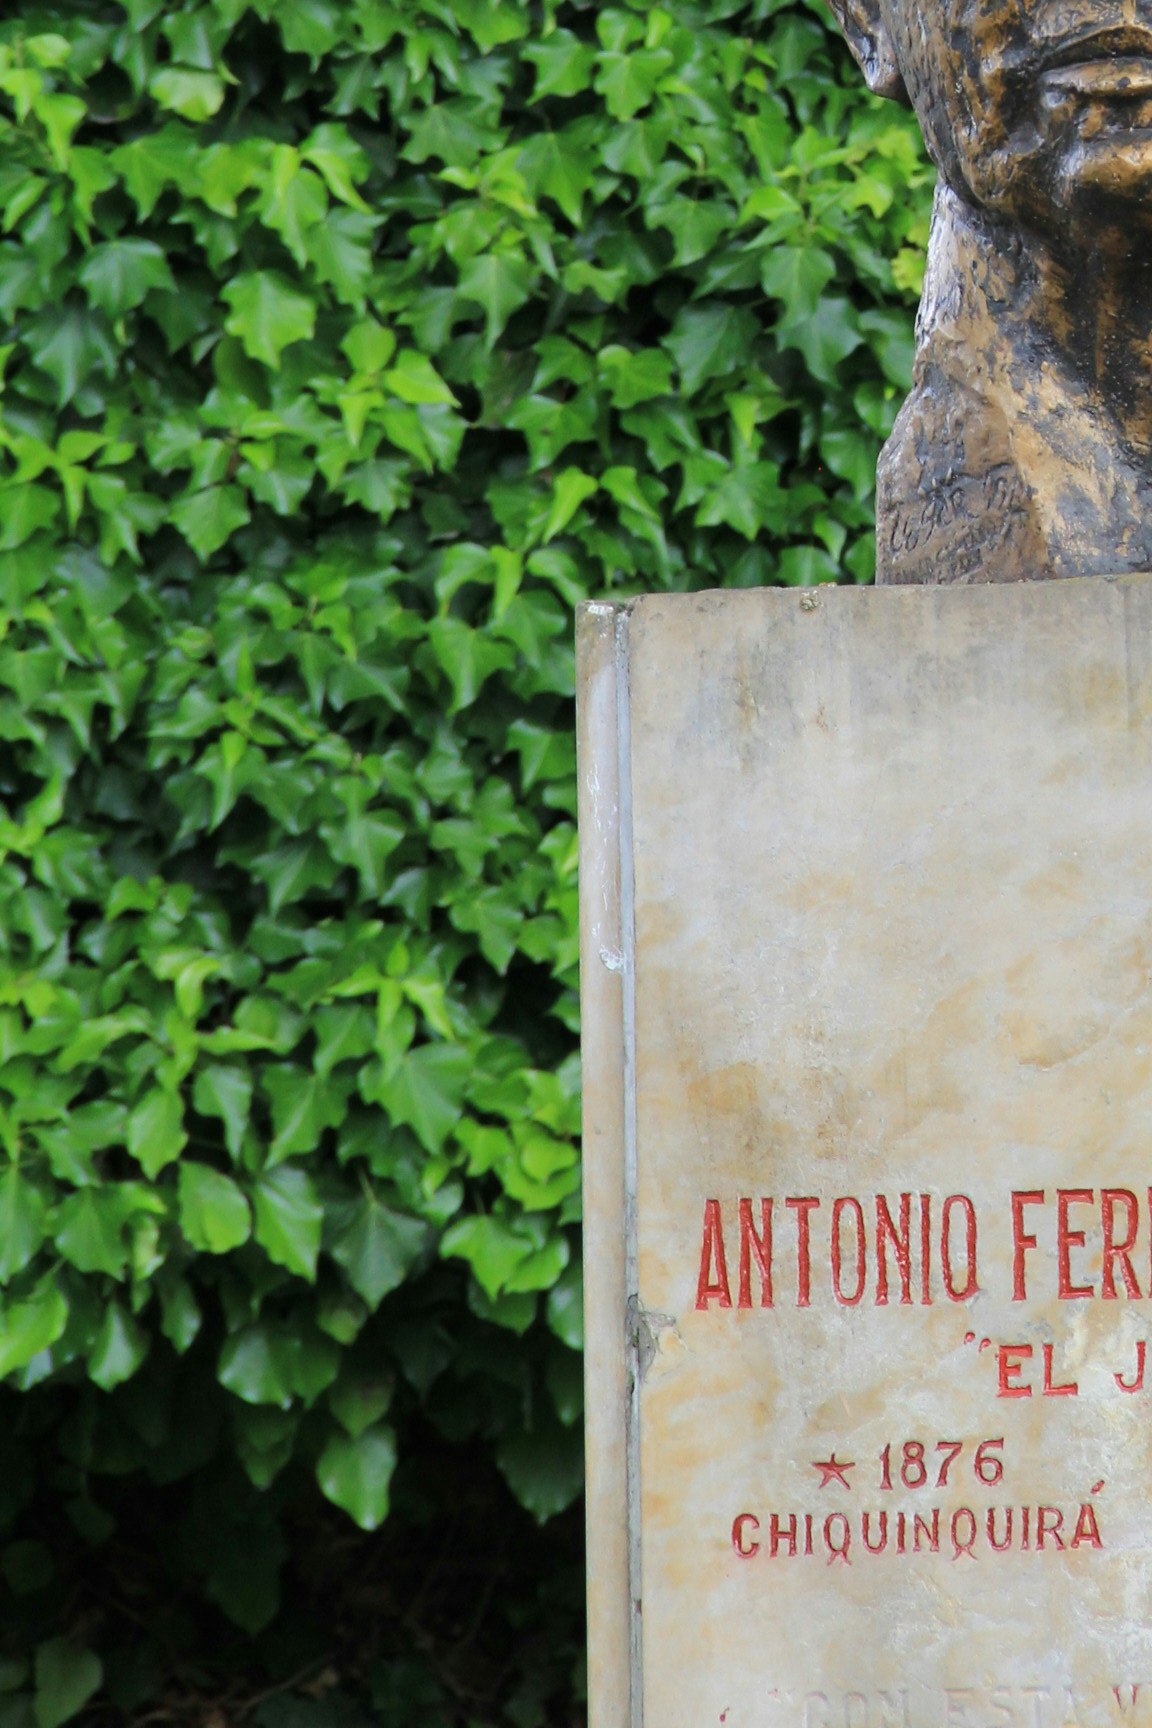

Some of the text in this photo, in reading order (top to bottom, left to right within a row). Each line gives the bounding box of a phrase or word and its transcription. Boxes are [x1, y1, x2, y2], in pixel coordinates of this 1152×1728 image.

[695, 1192, 979, 1312] ANTONIO
[879, 1438, 1004, 1490] 1876
[731, 1480, 1103, 1566] CHIQUINQUIRÁ
